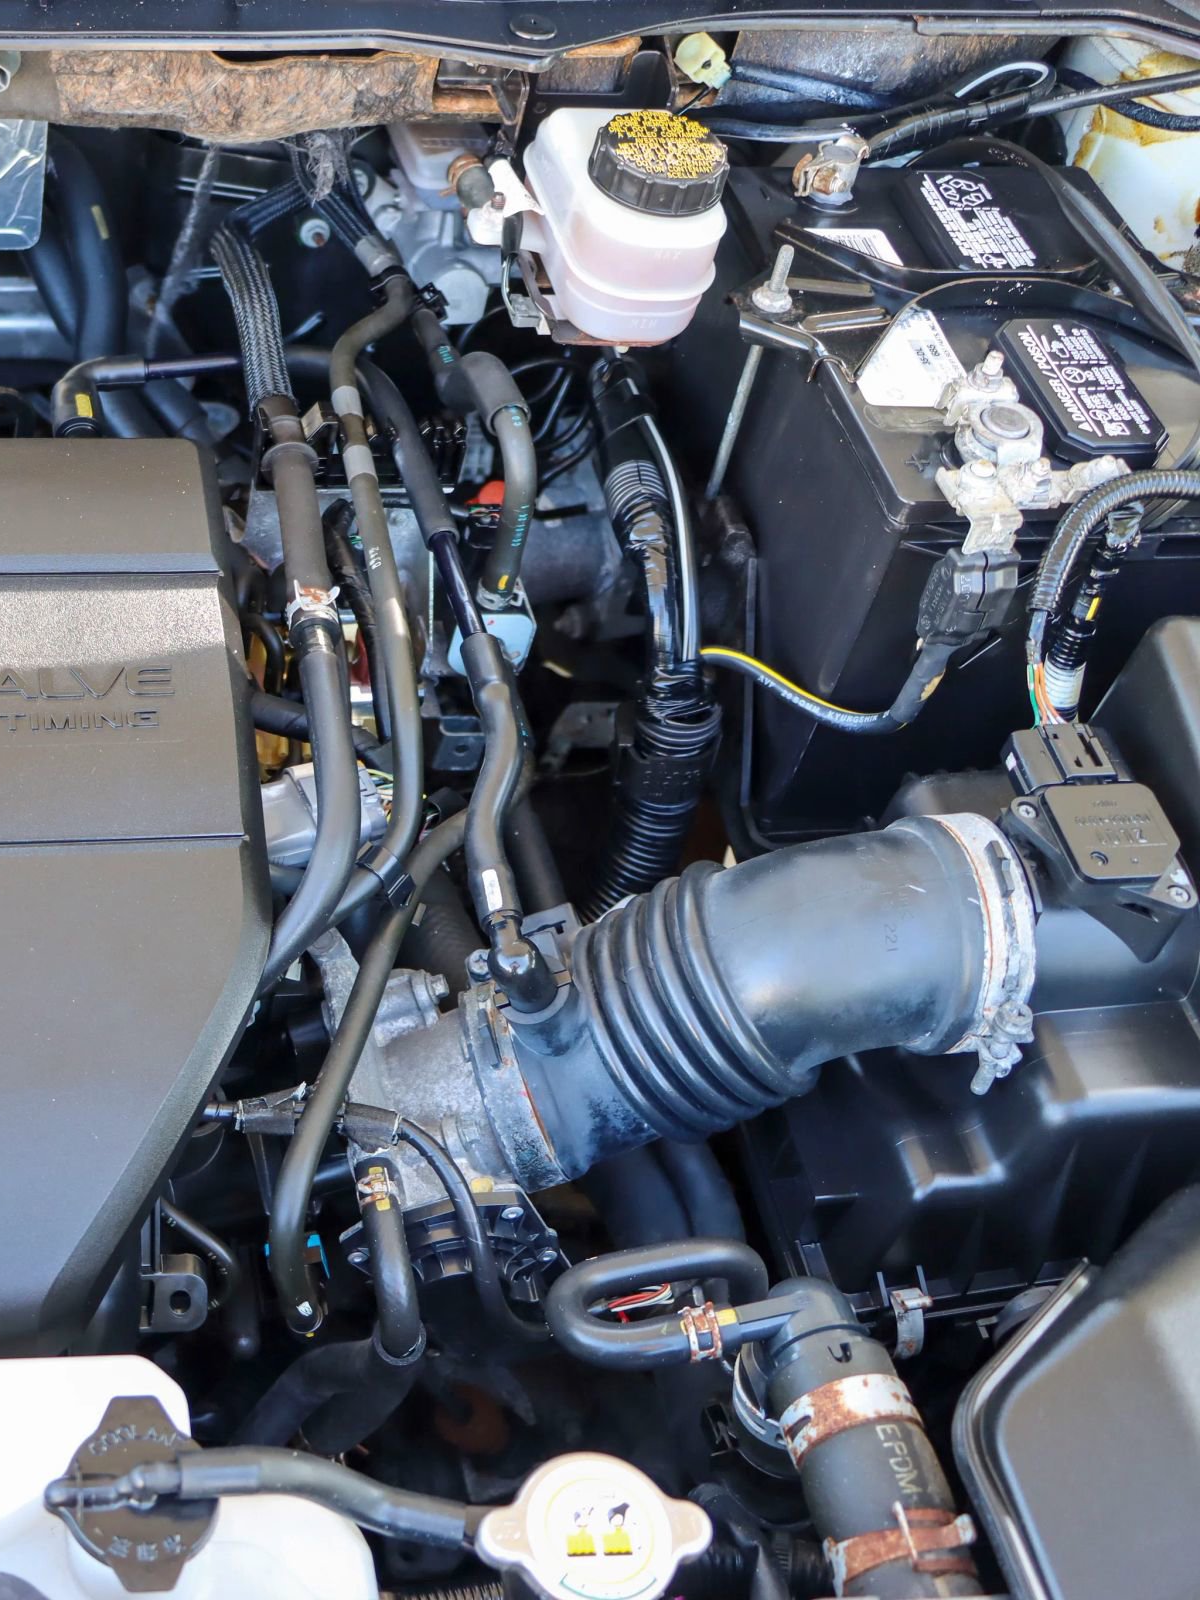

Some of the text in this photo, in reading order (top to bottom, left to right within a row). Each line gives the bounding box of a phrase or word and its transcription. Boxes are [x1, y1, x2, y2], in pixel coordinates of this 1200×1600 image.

[1017, 332, 1048, 369] POISON
[1048, 379, 1086, 421] DANGER
[828, 710, 879, 723] KYUNGSHIN
[875, 1424, 923, 1494] EPDM
